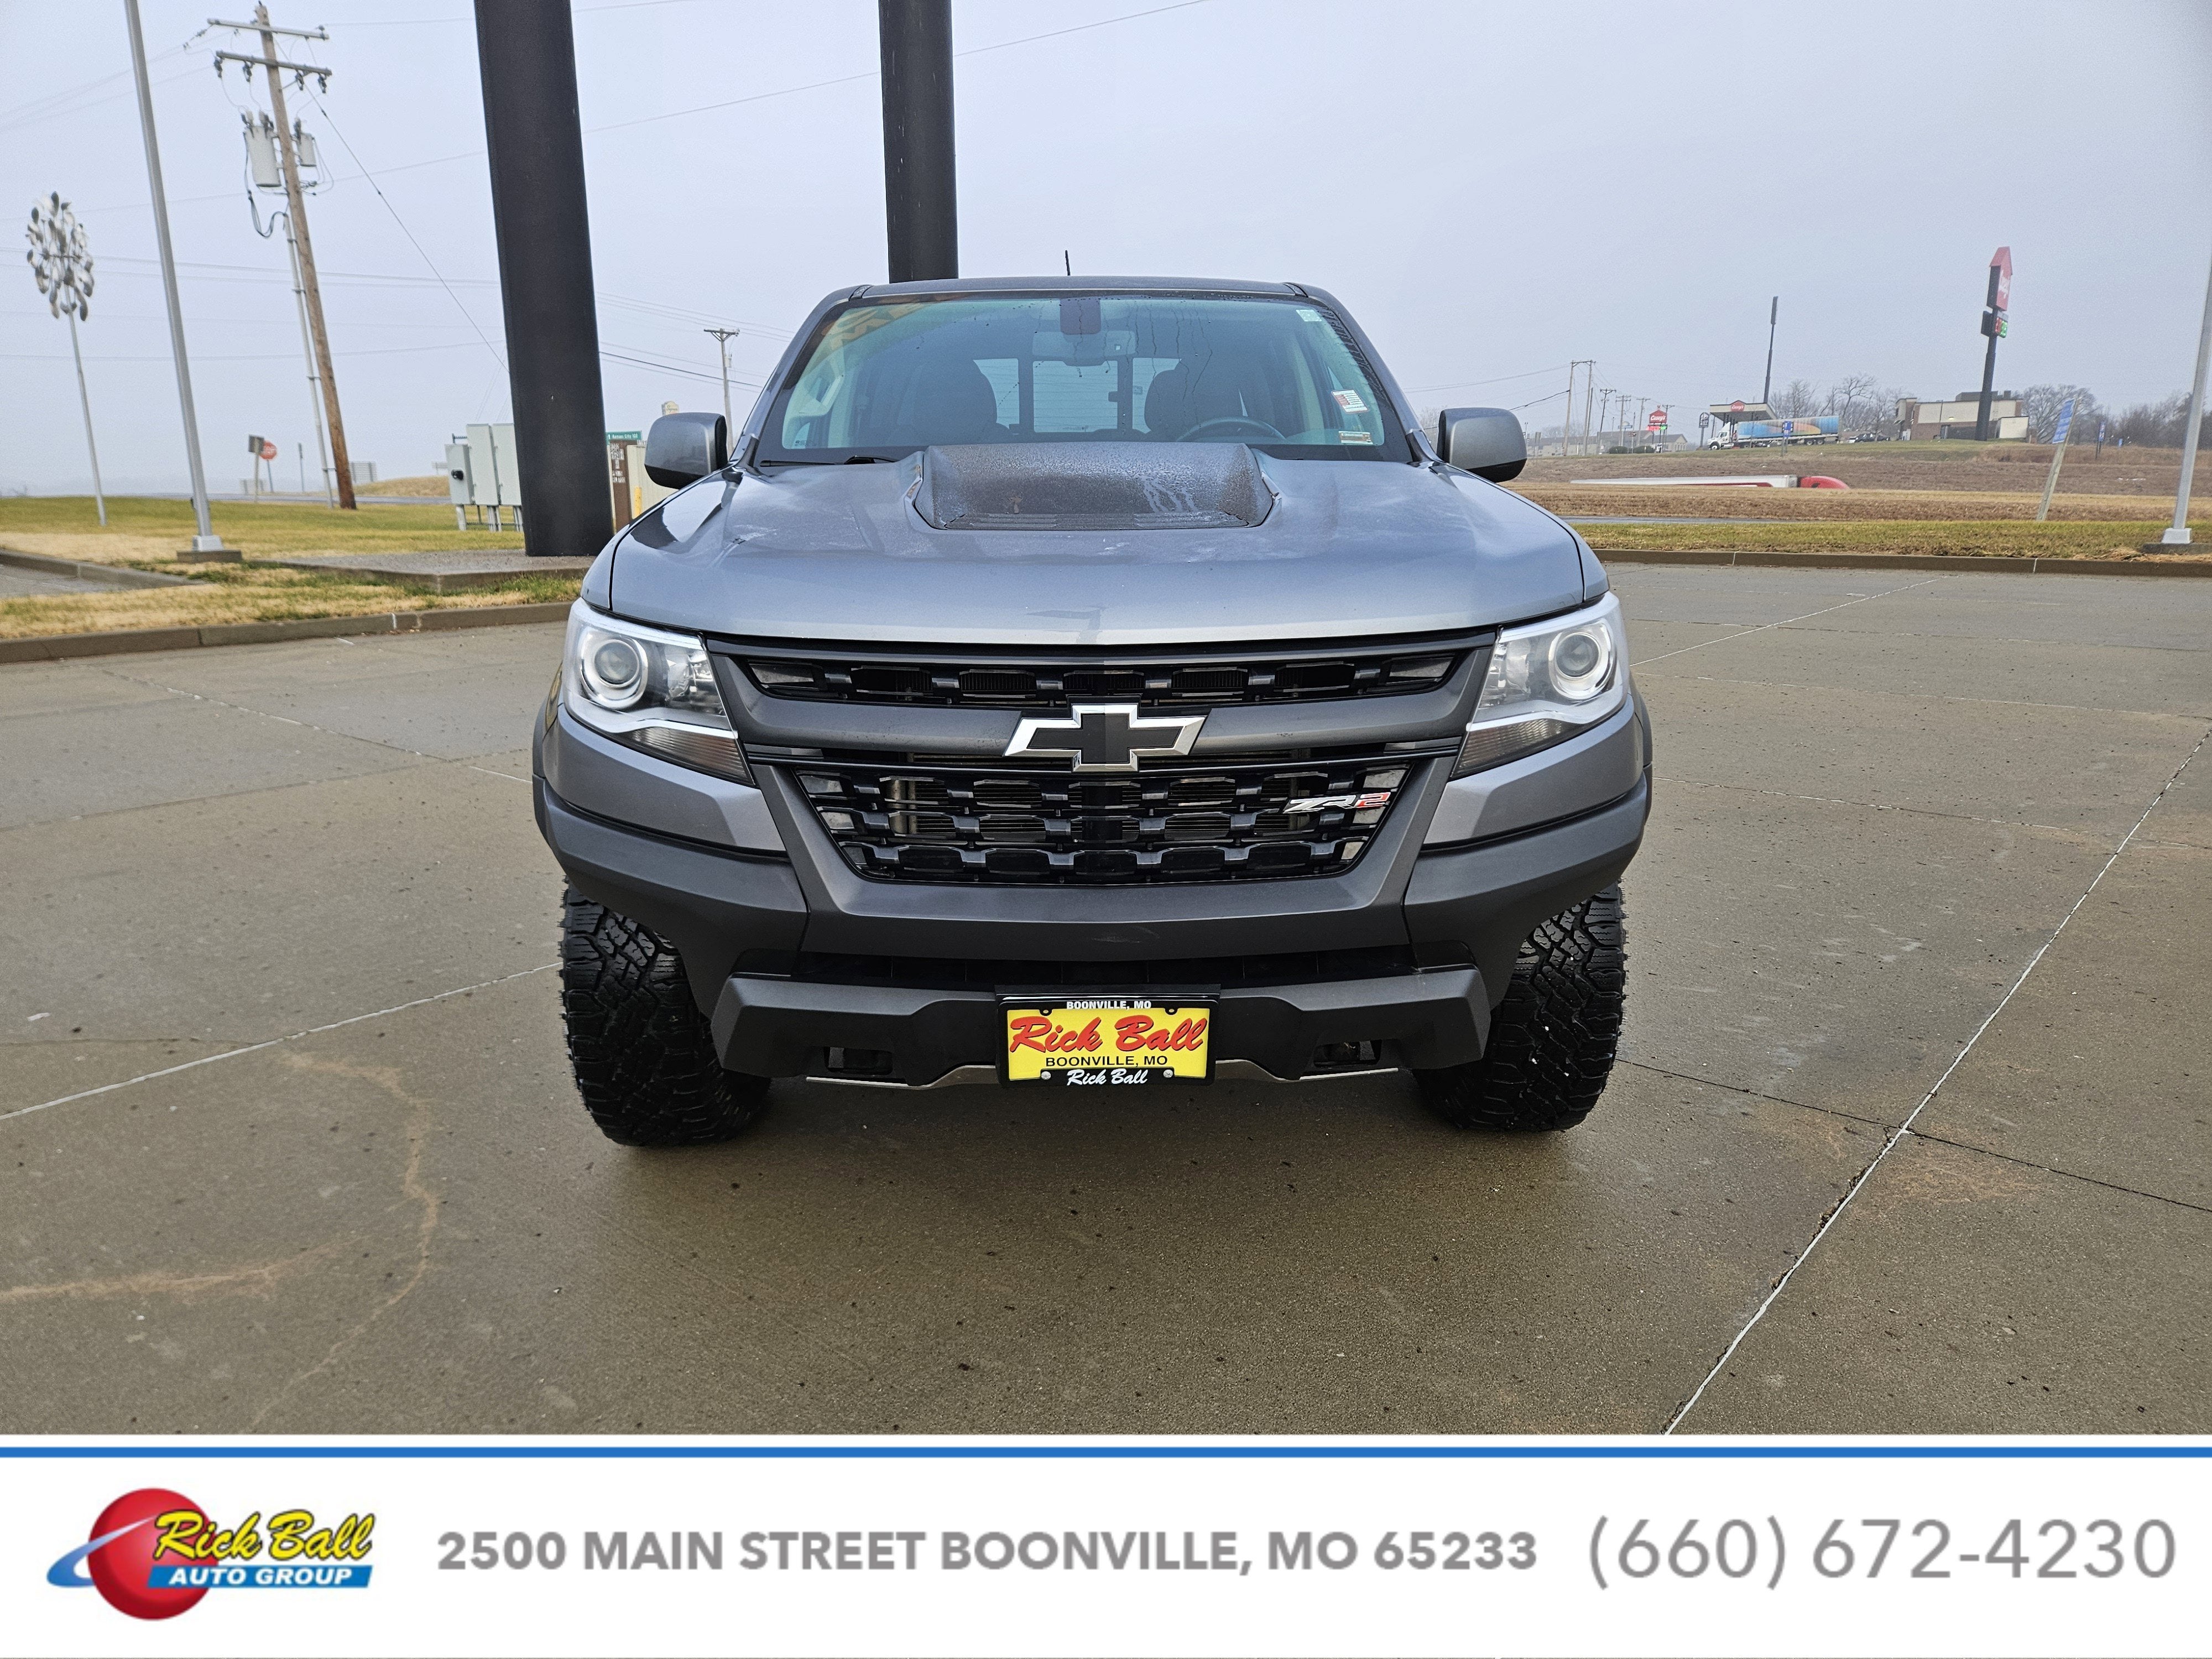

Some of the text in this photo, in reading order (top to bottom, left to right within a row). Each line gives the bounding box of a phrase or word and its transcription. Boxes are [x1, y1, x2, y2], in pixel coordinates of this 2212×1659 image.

[1282, 792, 1391, 814] ZR2
[1066, 1000, 1151, 1010] BOONVILLE, MO
[1009, 1015, 1207, 1052] Rick Ball
[1046, 1055, 1168, 1067] BOONVILLE, MO
[1066, 1068, 1147, 1086] Rick Ball
